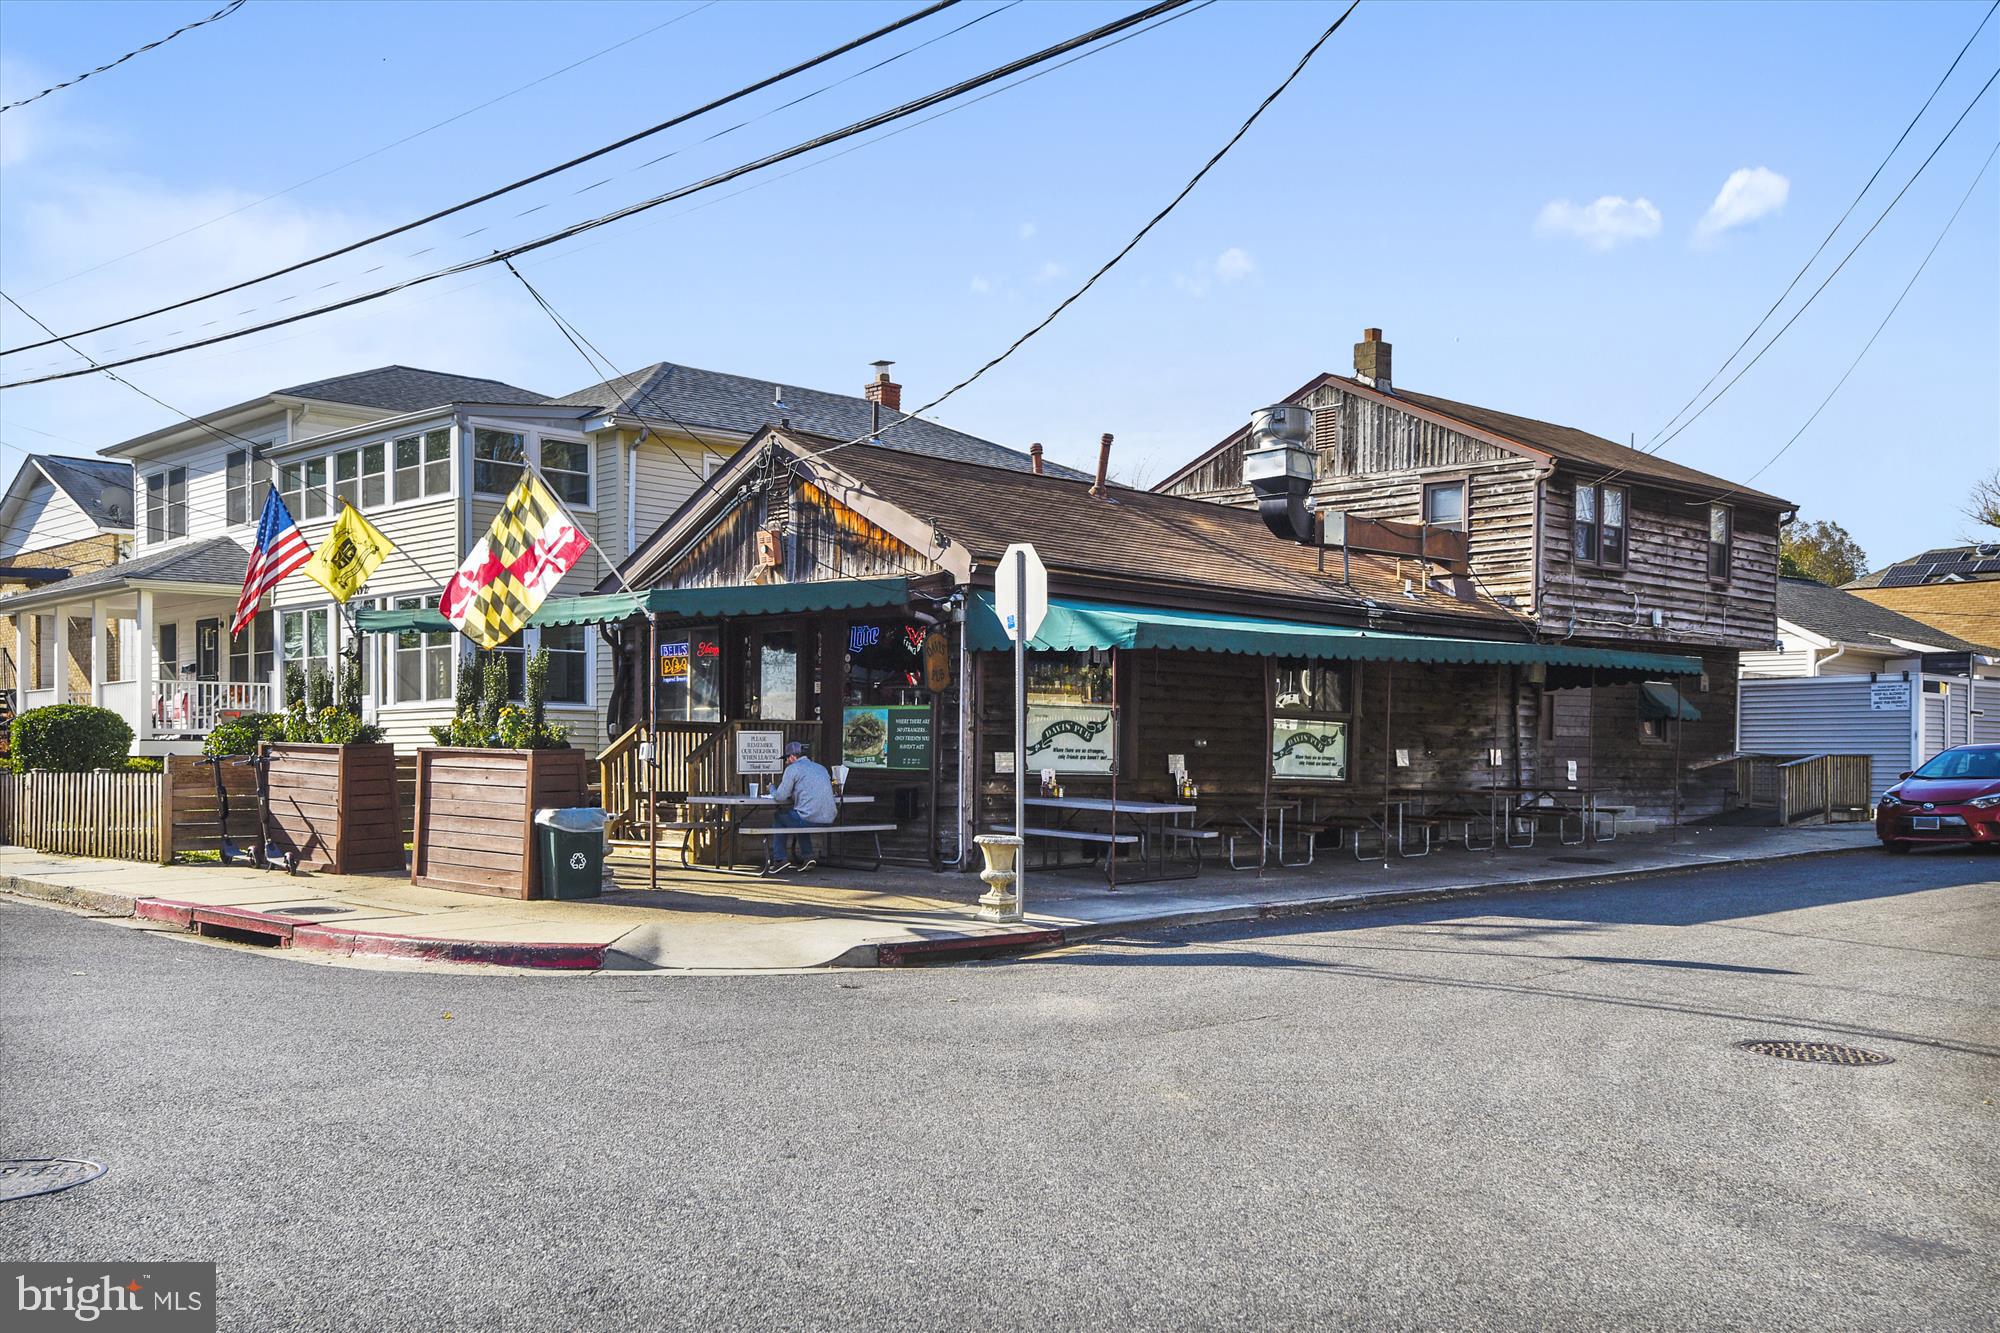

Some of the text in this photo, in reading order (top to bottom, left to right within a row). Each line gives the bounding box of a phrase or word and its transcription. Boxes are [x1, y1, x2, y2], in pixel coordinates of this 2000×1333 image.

[848, 625, 880, 653] Lite
[1074, 724, 1090, 740] PUB
[1310, 736, 1323, 750] PUB
